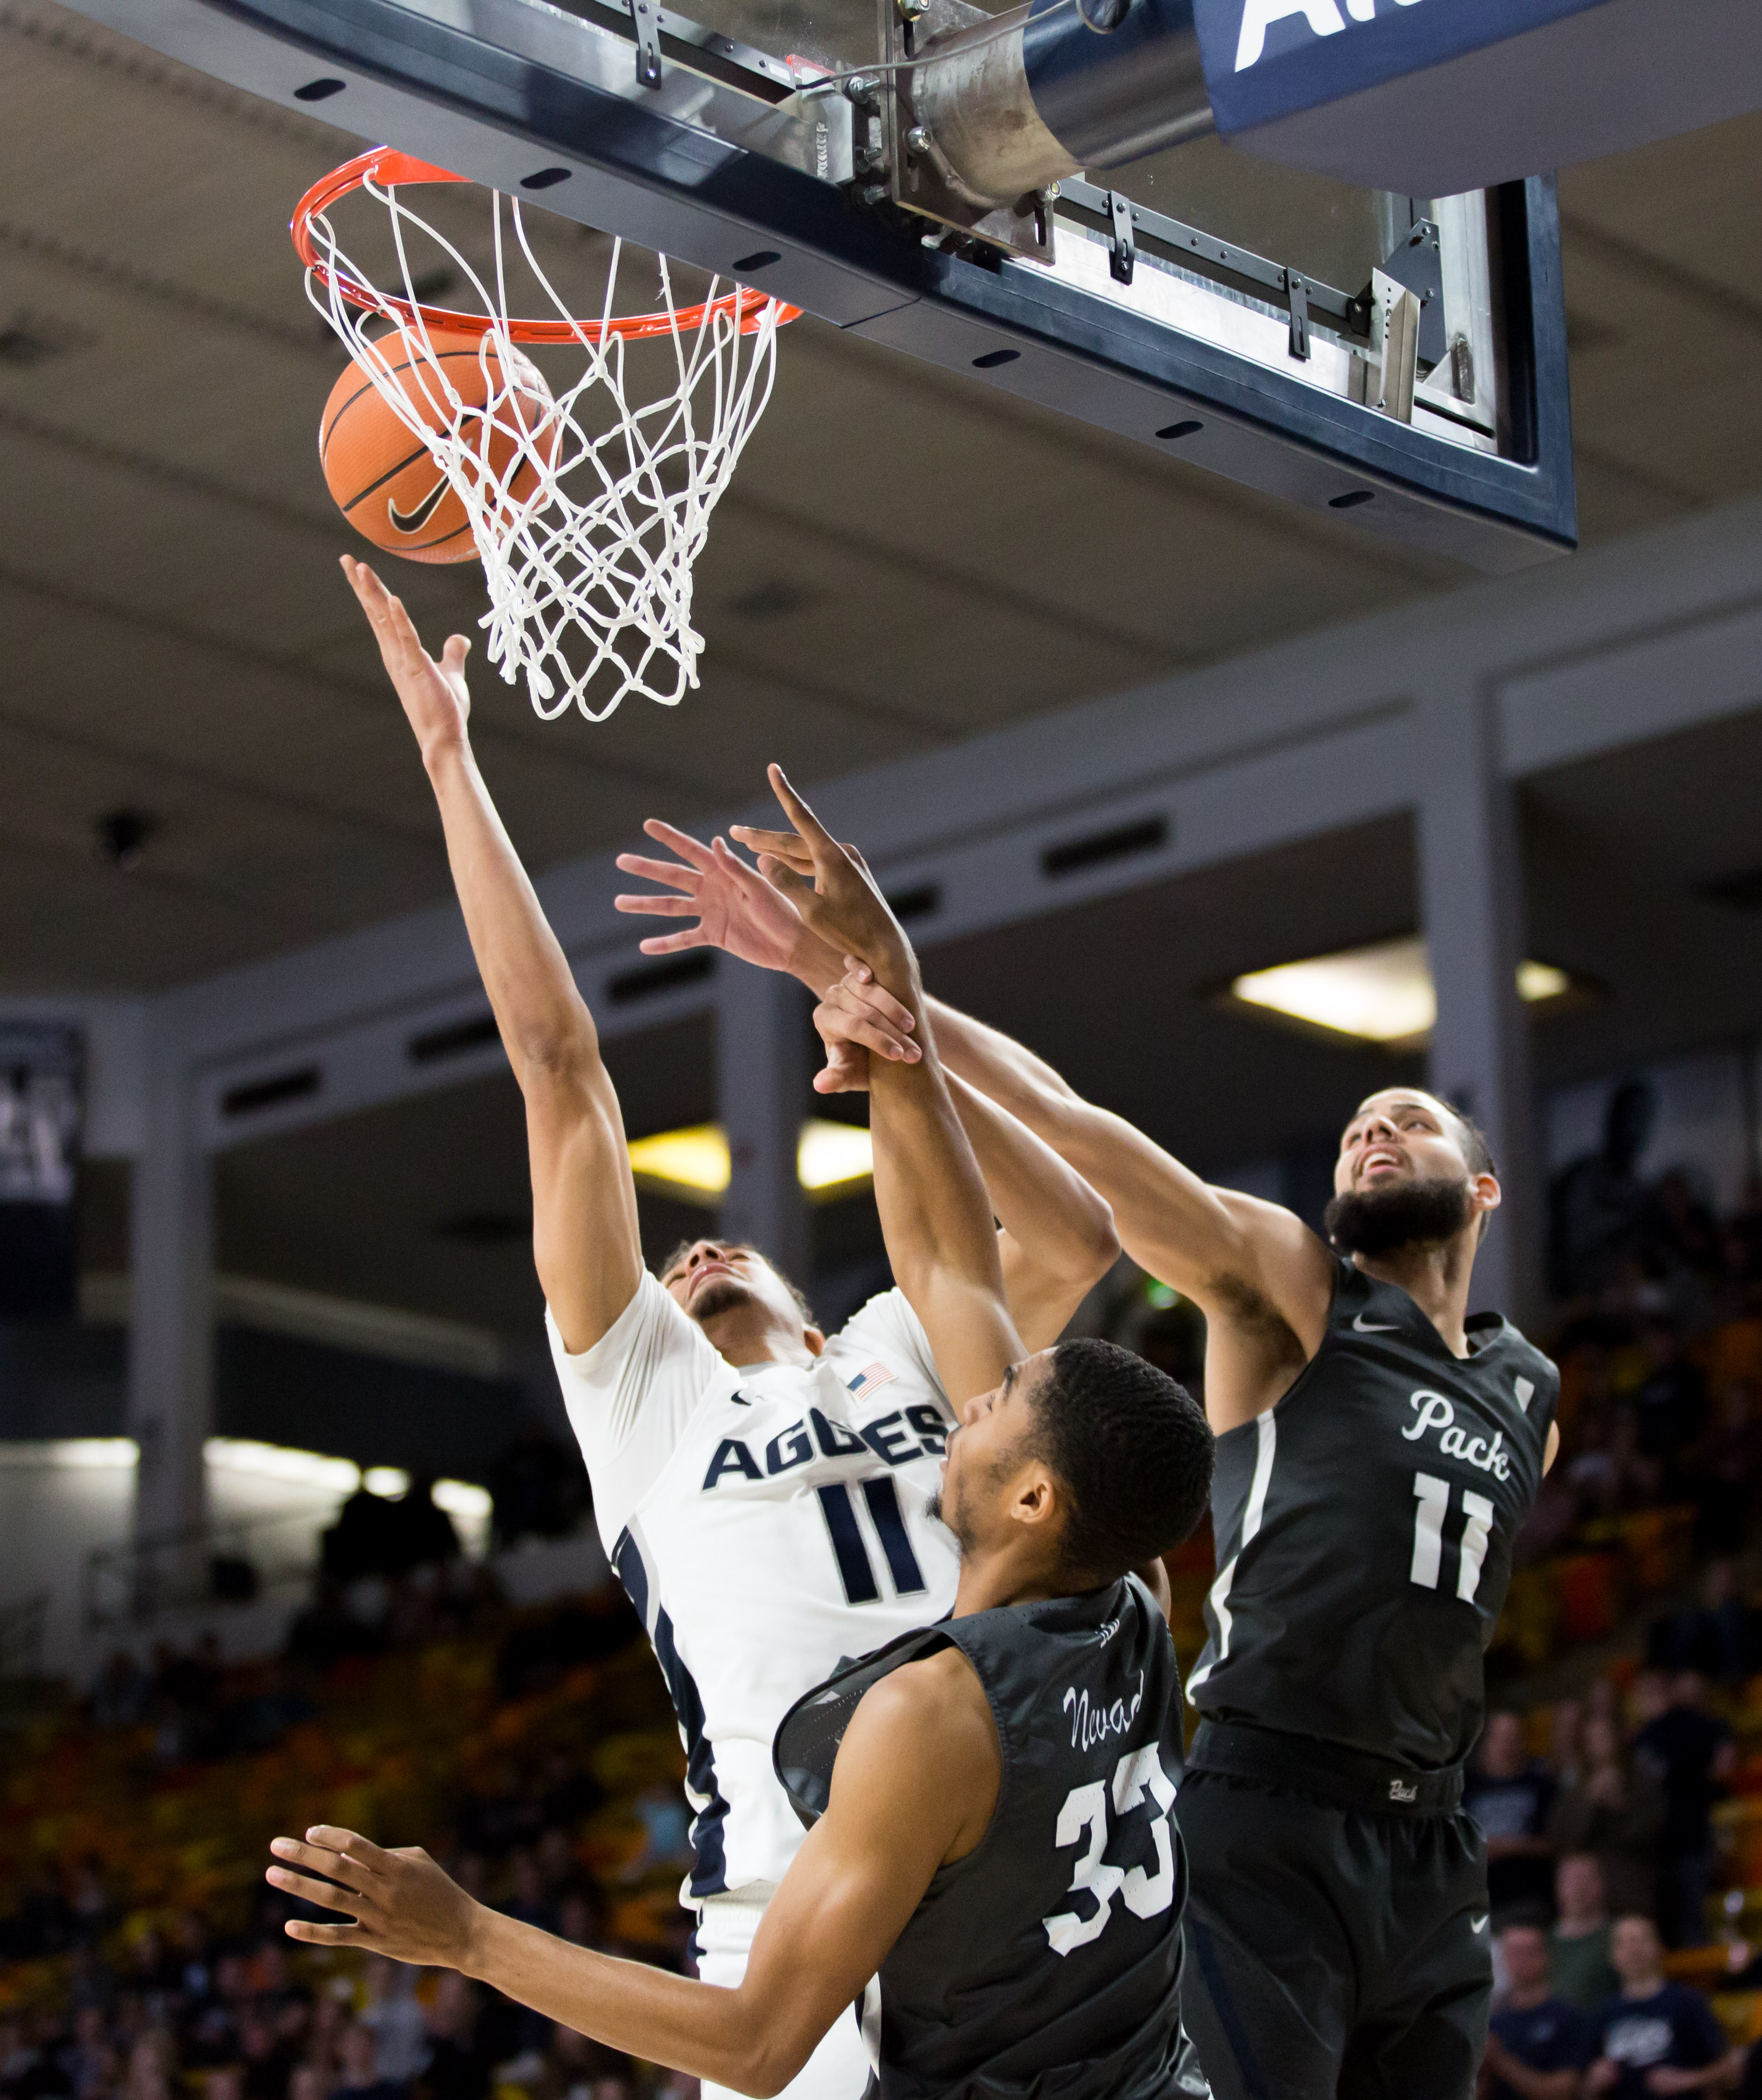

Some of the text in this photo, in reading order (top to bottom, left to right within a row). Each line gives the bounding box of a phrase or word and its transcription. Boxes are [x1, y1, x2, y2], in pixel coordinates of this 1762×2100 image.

[700, 1404, 950, 1492] AGGES
[1401, 1388, 1511, 1482] Pack
[813, 1472, 930, 1608] 11
[1409, 1471, 1495, 1604] 11
[1063, 1668, 1144, 1752] Nevad
